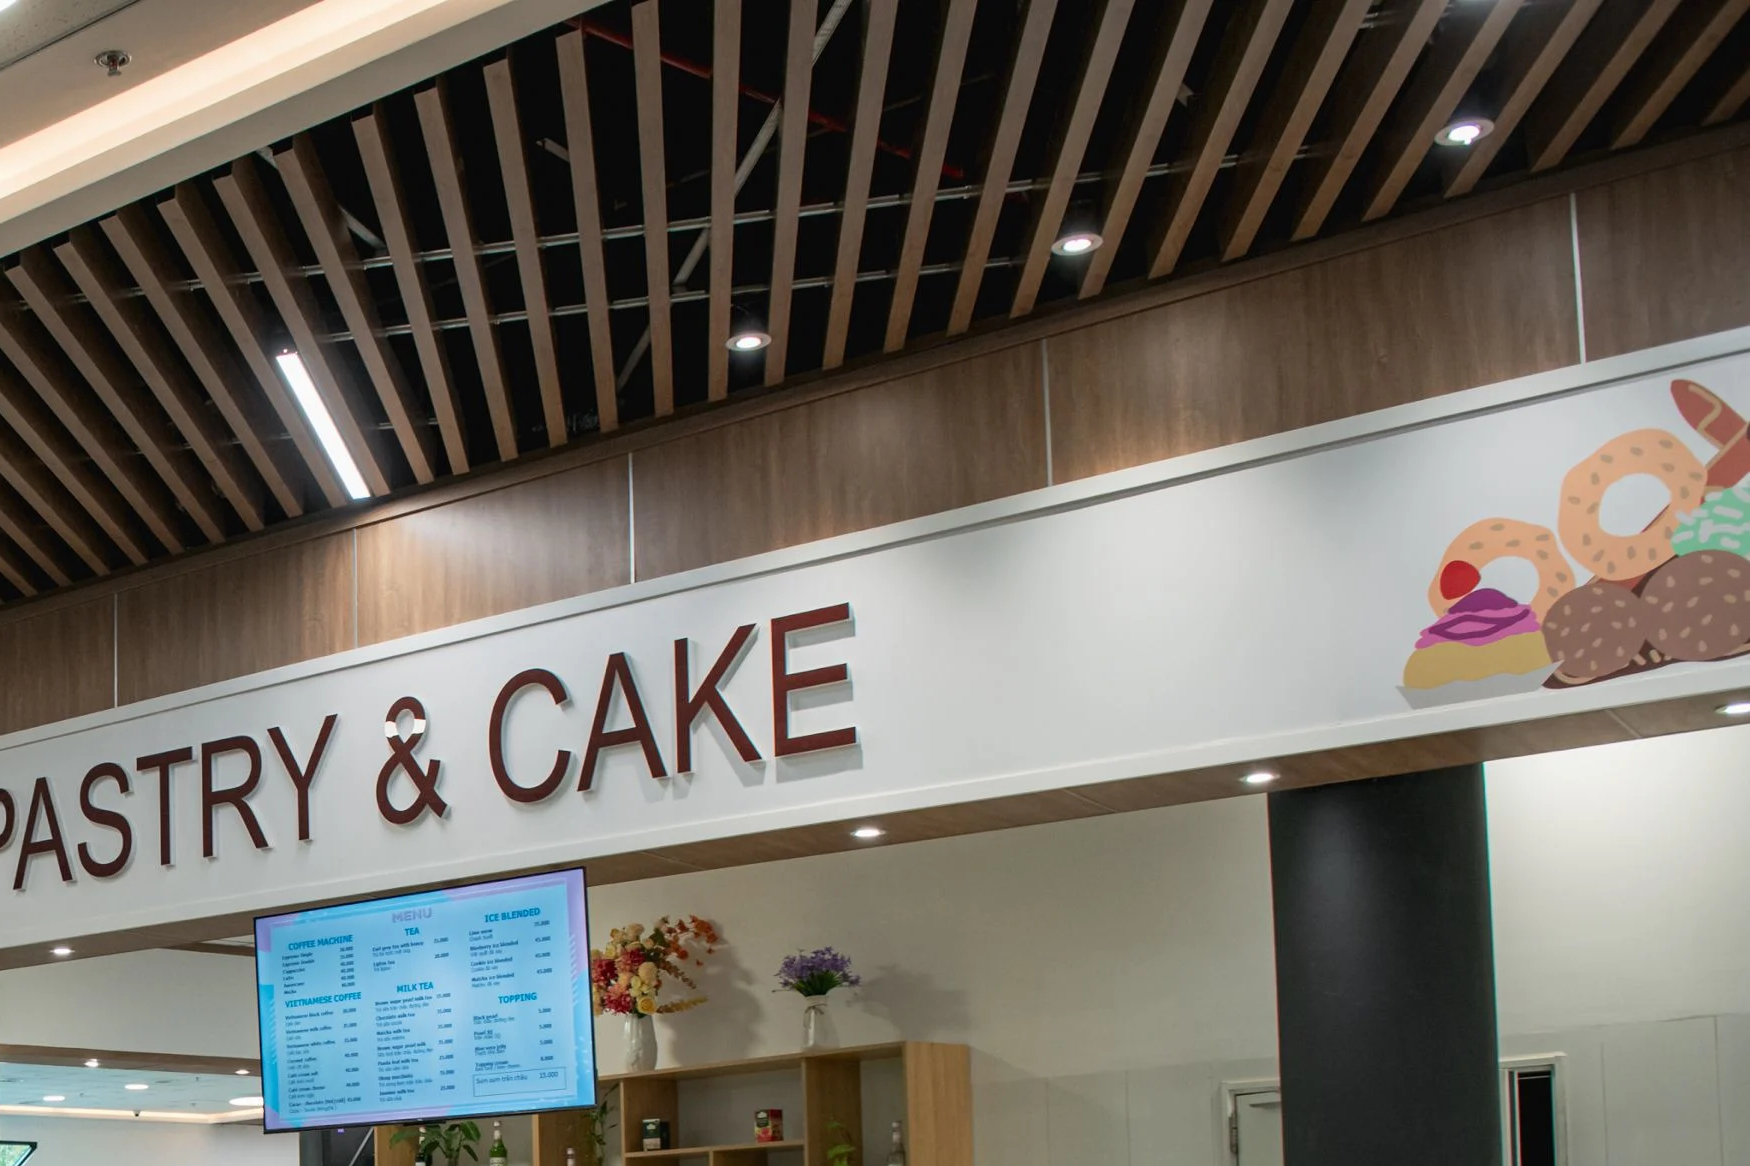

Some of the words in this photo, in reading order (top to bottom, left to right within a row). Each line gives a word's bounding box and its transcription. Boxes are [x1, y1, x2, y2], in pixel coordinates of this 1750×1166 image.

[376, 696, 447, 826] &
[489, 602, 856, 804] CAKE
[391, 907, 432, 923] MENU
[484, 913, 499, 922] ICE
[501, 907, 540, 920] BLENDED
[405, 927, 419, 936] TEA
[288, 940, 315, 950] COFFEE
[317, 935, 353, 946] MACHINE
[397, 983, 417, 993] MILK
[420, 982, 434, 990] TEA
[285, 996, 332, 1008] VIETNAMESE
[334, 992, 361, 1002] COFFEE
[498, 992, 537, 1004] TOPPING
